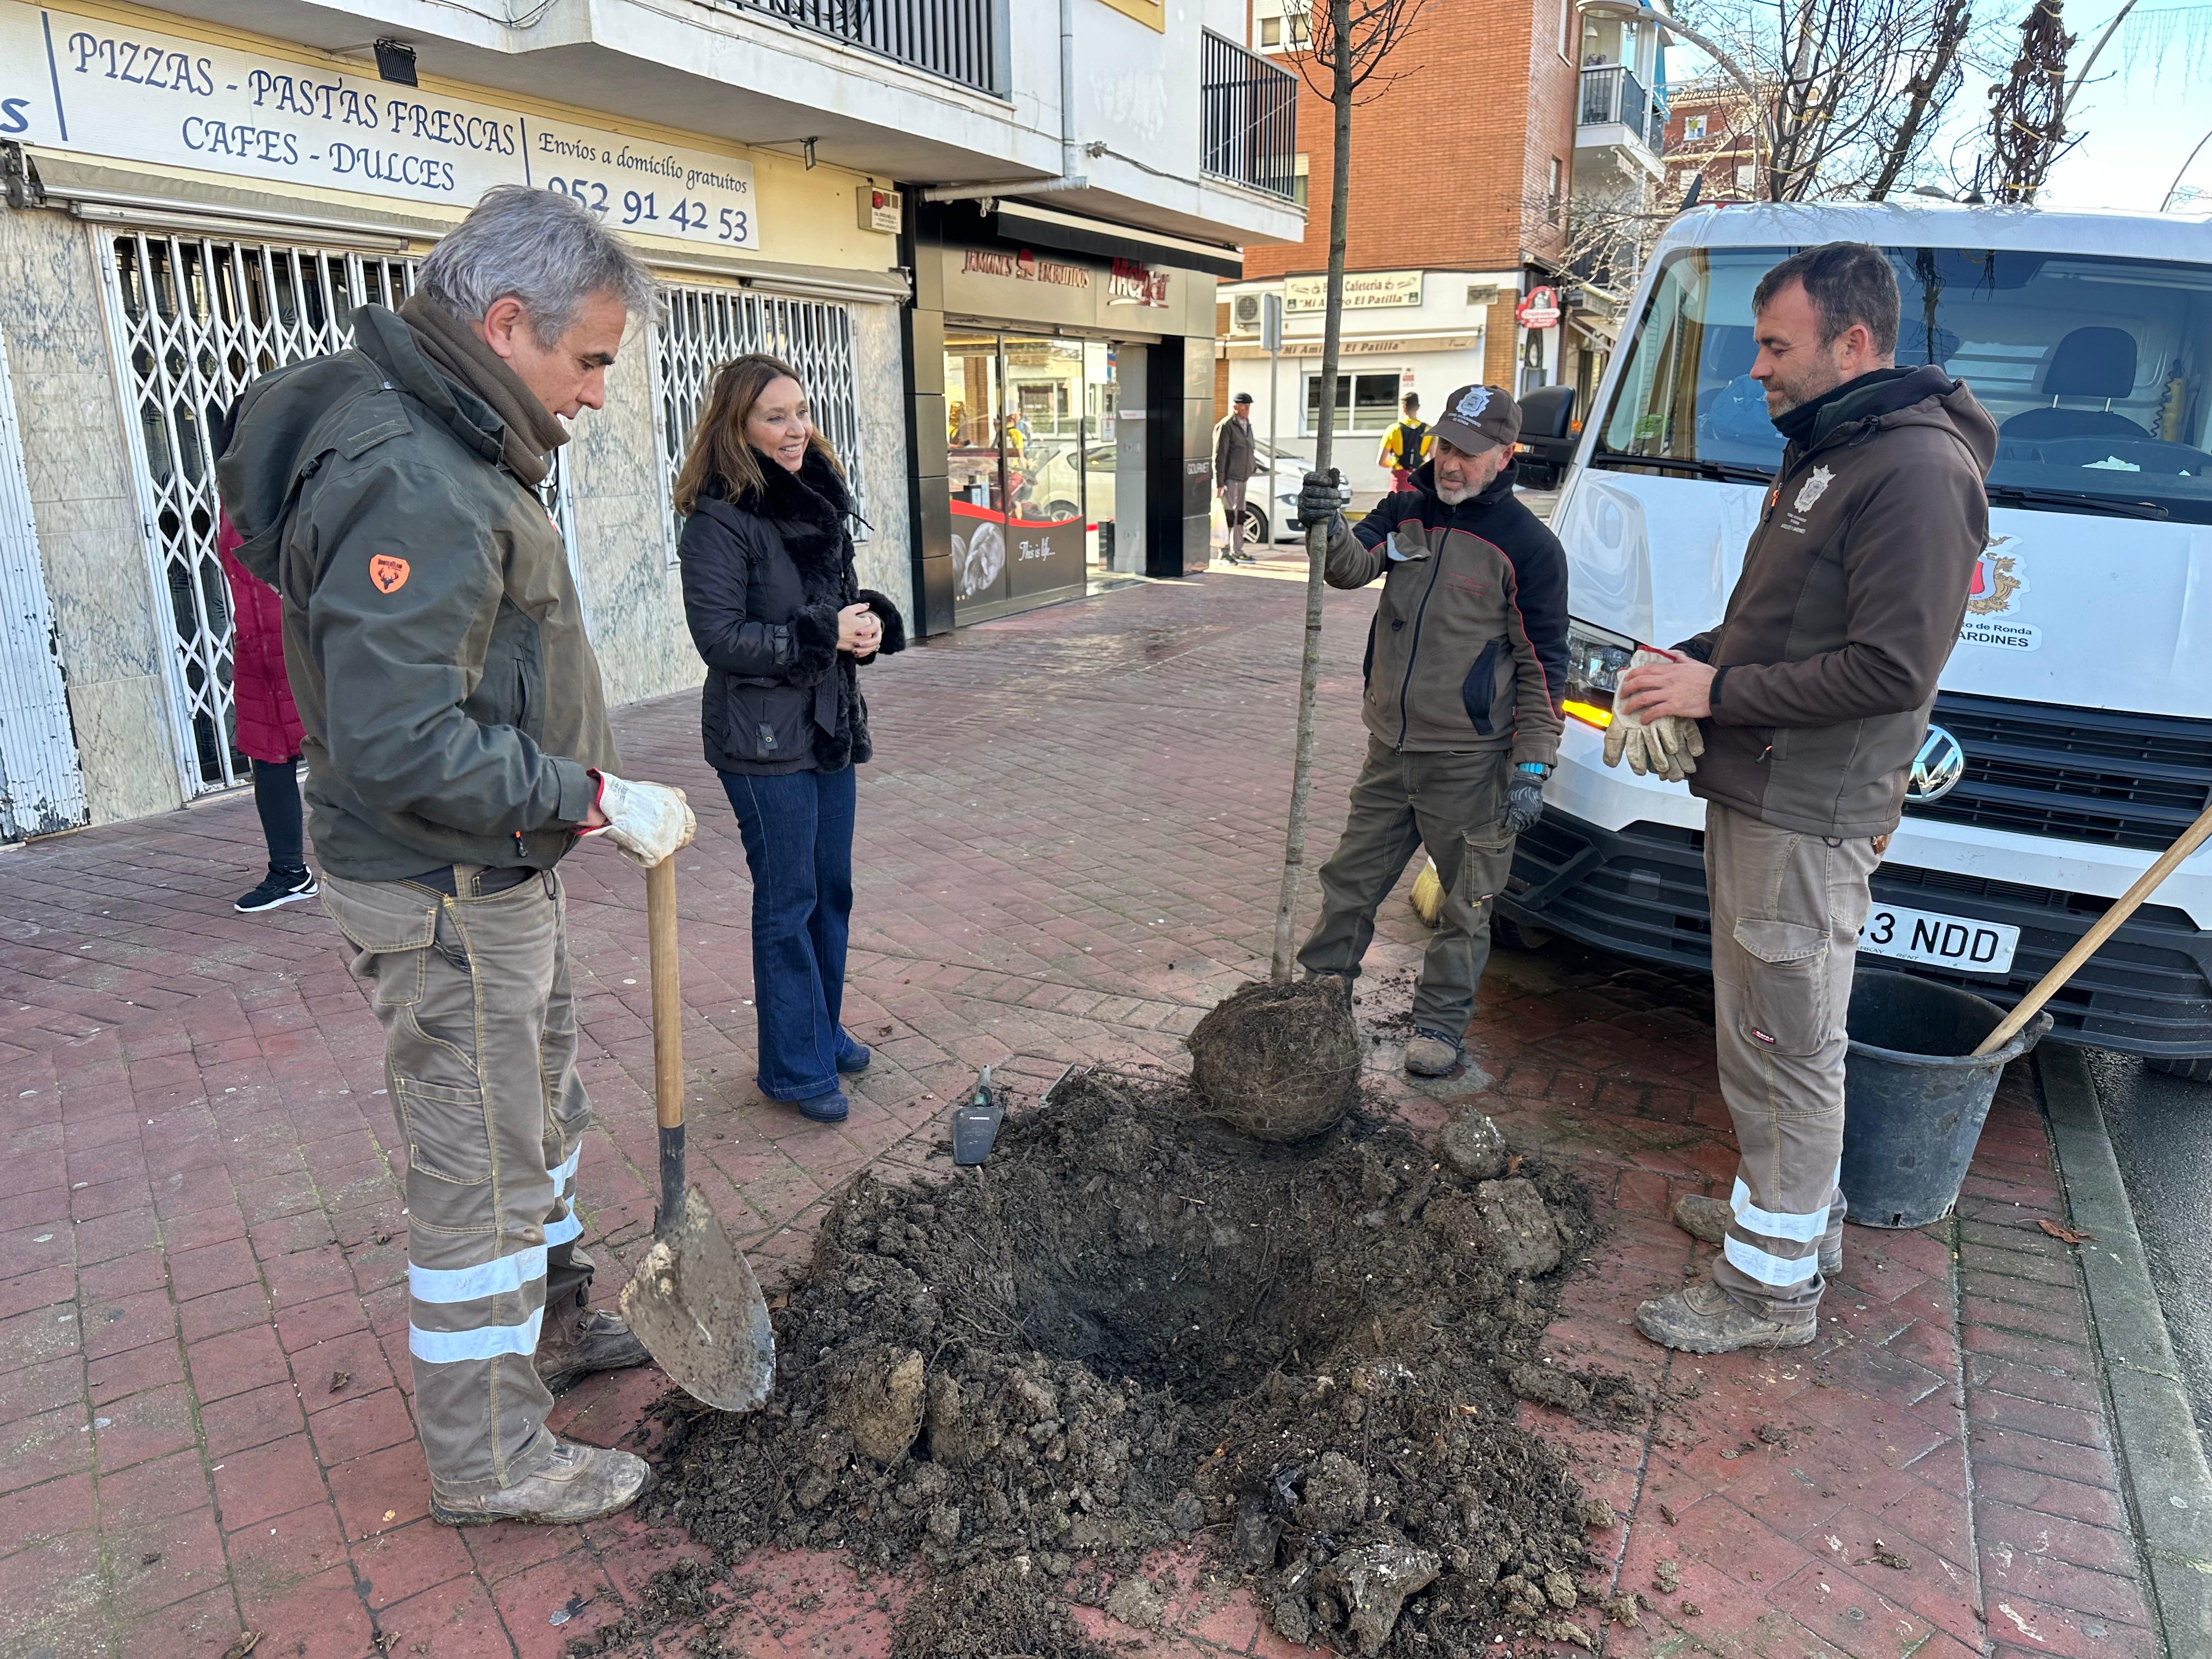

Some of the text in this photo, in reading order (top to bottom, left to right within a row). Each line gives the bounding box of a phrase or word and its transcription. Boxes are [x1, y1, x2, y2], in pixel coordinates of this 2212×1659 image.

[69, 32, 214, 97] PIZZAS
[248, 69, 378, 129] PASTAS
[387, 100, 515, 155] FRESCAS
[182, 116, 298, 165] CAFES
[329, 143, 455, 191] DULCES
[602, 150, 612, 164] a
[617, 145, 683, 179] domicilio
[686, 169, 747, 194] gratuitos
[622, 190, 659, 224] 91
[668, 197, 708, 232] 42
[718, 207, 747, 242] 53
[961, 249, 1090, 288] JAMONES EMBUTIDOS
[1354, 296, 1365, 305] El
[1300, 345, 1323, 354] Ami
[1345, 342, 1356, 352] El
[1959, 631, 2029, 647] ARDINES
[1994, 624, 2032, 635] Ronda
[1857, 945, 1920, 961] RKAY RENT
[1858, 912, 1999, 963] 3 NDD
